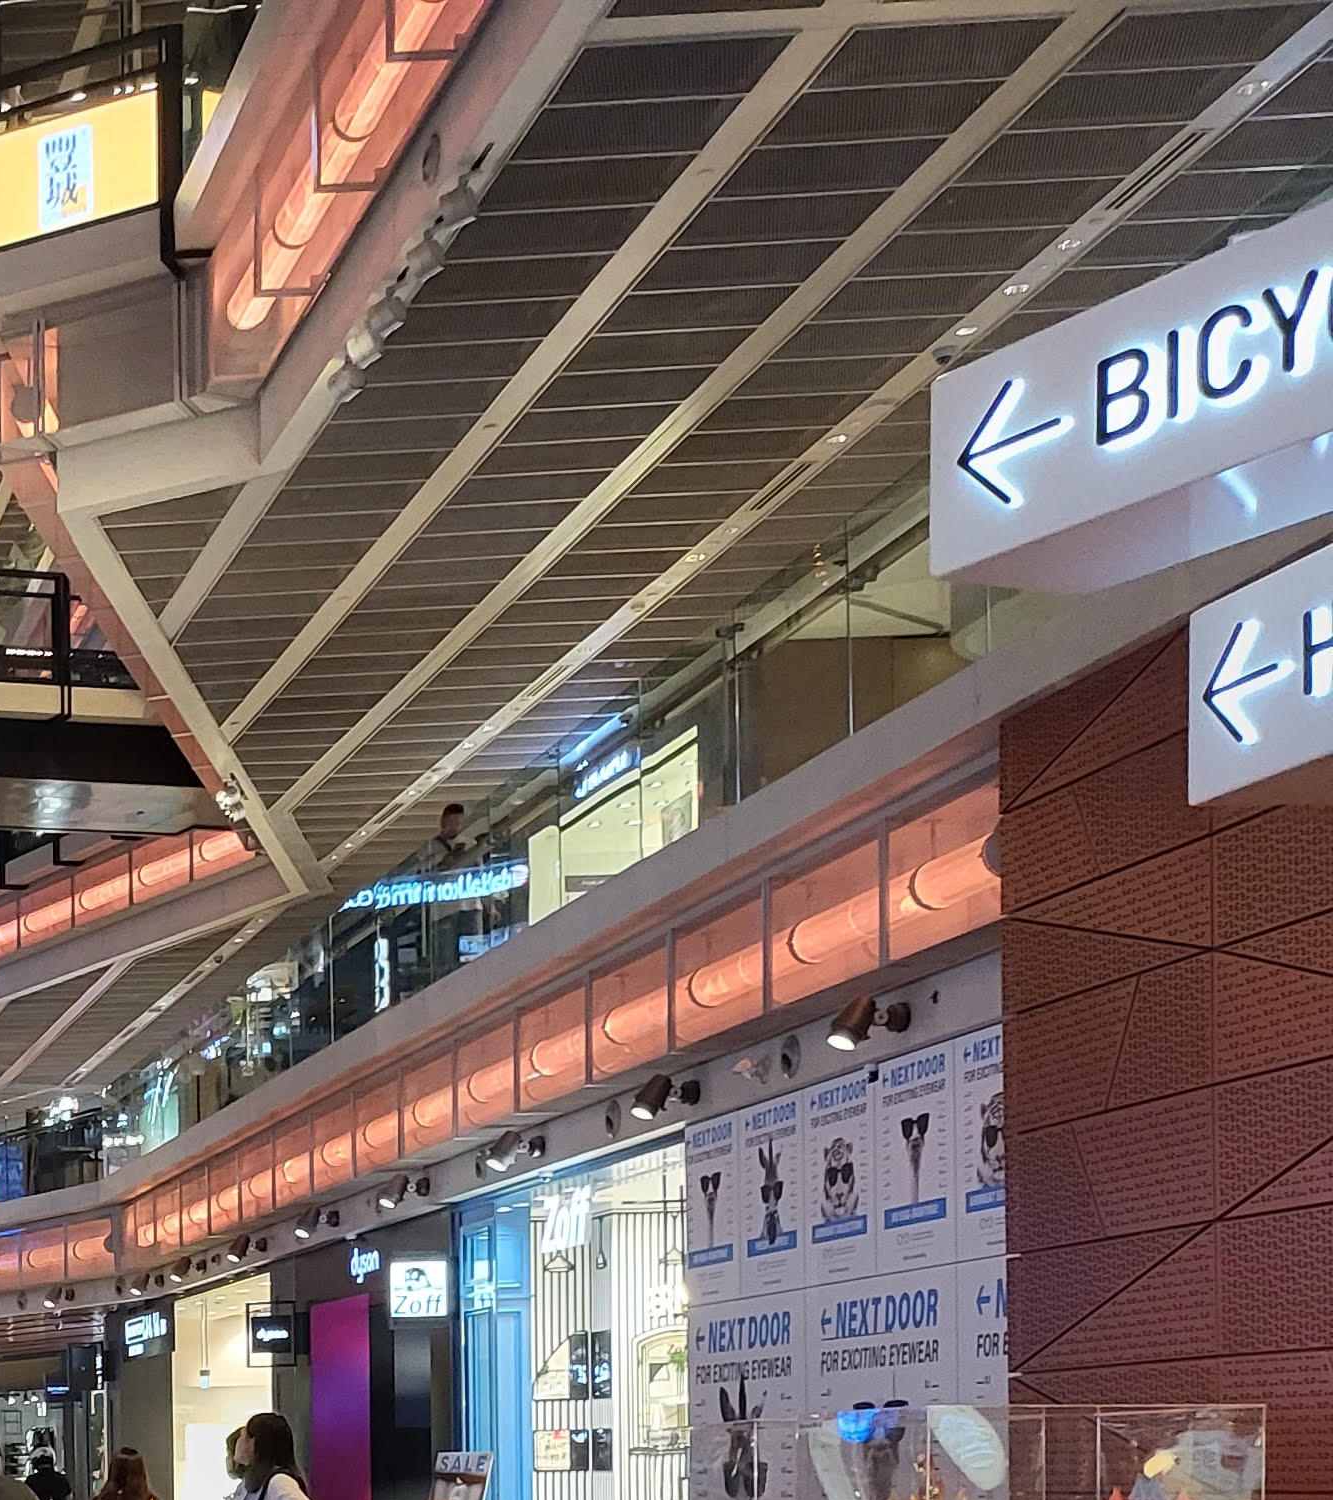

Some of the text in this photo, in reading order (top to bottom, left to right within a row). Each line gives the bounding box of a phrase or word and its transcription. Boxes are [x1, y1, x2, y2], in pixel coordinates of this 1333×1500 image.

[1095, 266, 1333, 447] BICY
[972, 1034, 1001, 1063] NEXT
[890, 1052, 946, 1089] NEXT DOOR
[817, 1078, 867, 1111] NEXT DOOR
[540, 1184, 593, 1254] Zoff
[349, 1247, 380, 1285] dyson
[393, 1294, 443, 1315] Zoff
[835, 1287, 939, 1339] NEXT DOOR
[707, 1310, 792, 1354] NEXT DOOR
[976, 1331, 1001, 1359] FOR
[695, 1365, 712, 1386] FOR
[751, 1355, 793, 1381] EYEWEAR
[820, 1339, 940, 1373] FOR EXCITING EYEWEAR
[440, 1455, 487, 1472] SALE
